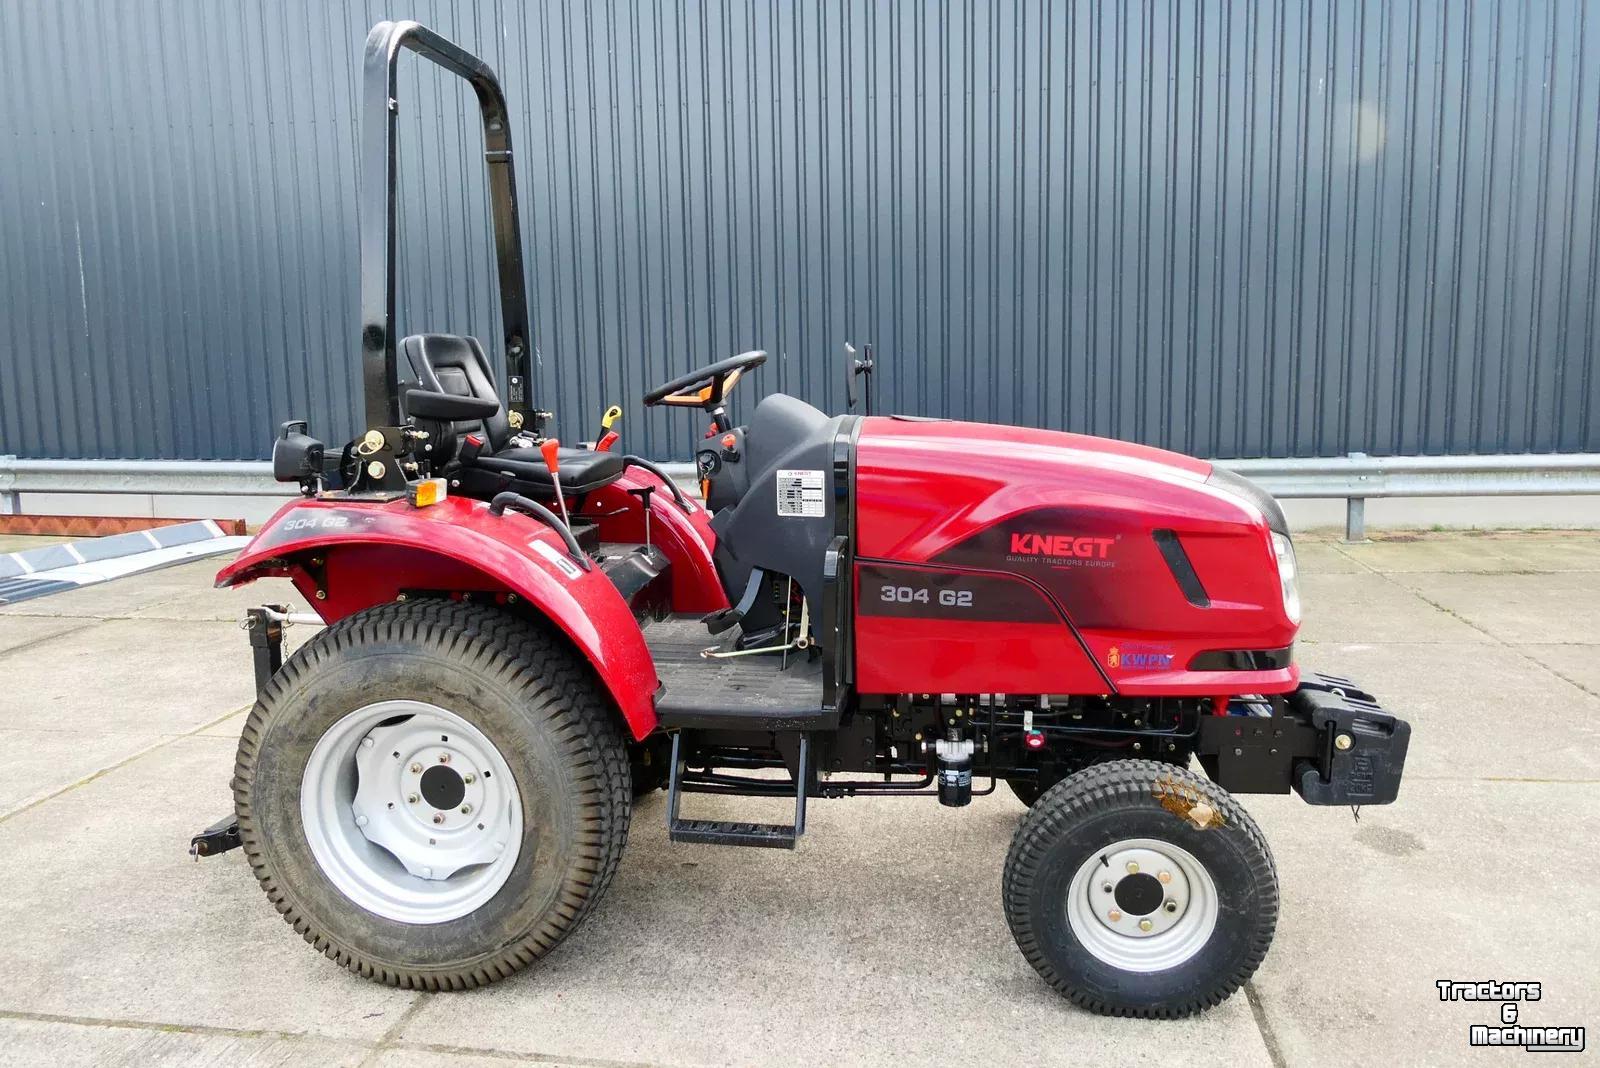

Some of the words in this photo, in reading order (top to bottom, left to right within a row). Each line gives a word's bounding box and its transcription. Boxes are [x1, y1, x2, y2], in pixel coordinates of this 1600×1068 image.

[284, 518, 317, 531] 304
[1011, 533, 1115, 558] KNEGT
[1042, 557, 1082, 566] TRACTORS
[1085, 560, 1115, 568] EUROPE
[880, 585, 930, 604] 304
[939, 589, 973, 607] G2
